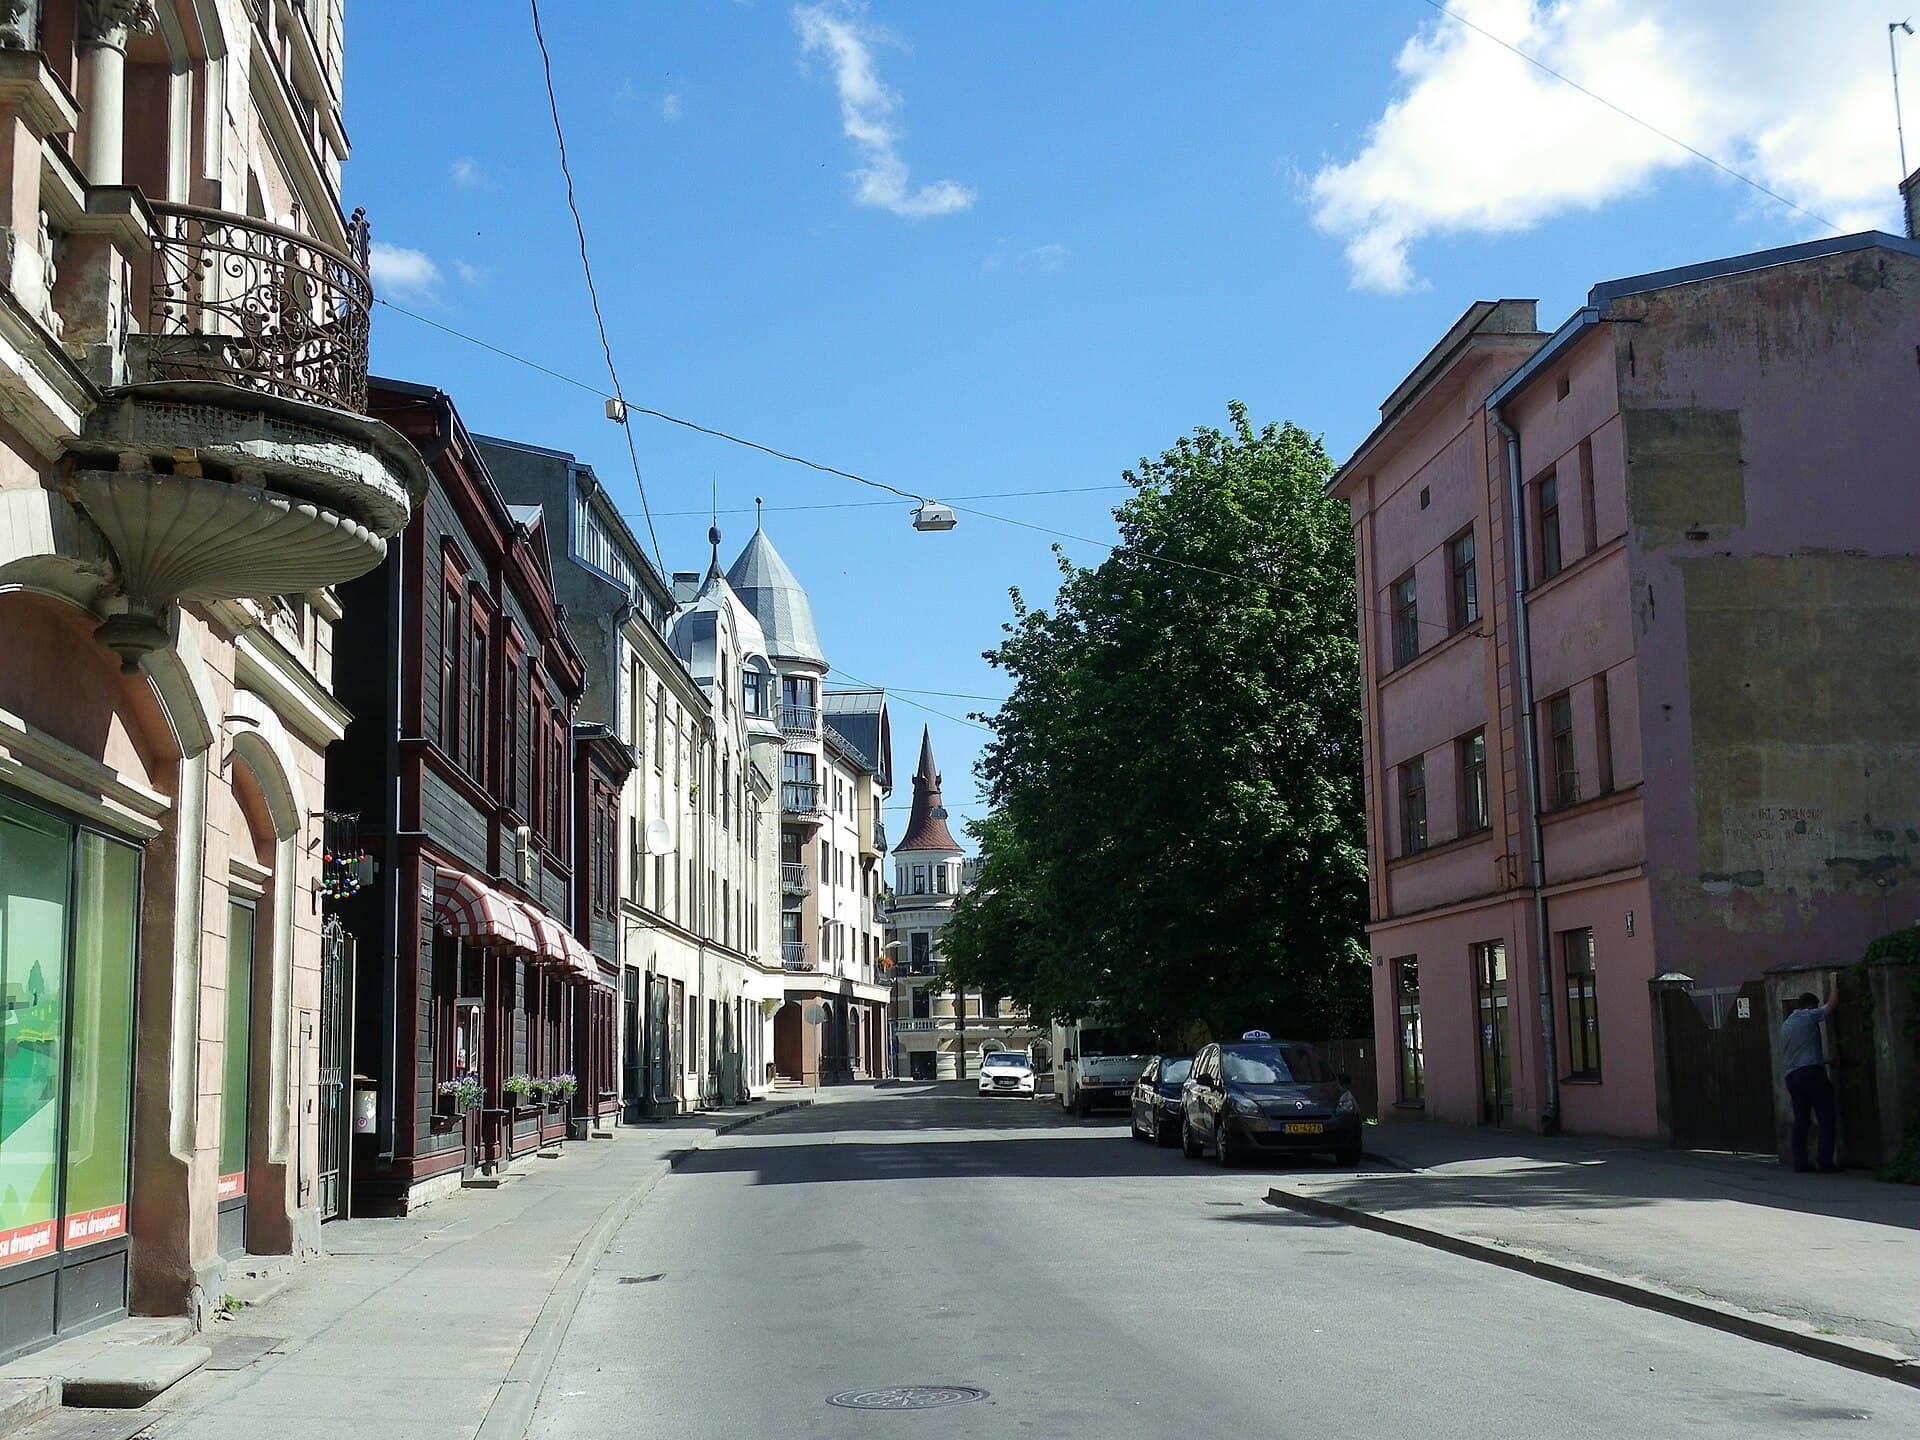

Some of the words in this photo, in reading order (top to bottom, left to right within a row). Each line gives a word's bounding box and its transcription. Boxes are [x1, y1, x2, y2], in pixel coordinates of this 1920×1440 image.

[88, 1208, 122, 1236] draugiem!
[0, 1240, 10, 1258] su
[10, 1223, 51, 1256] draugiem!
